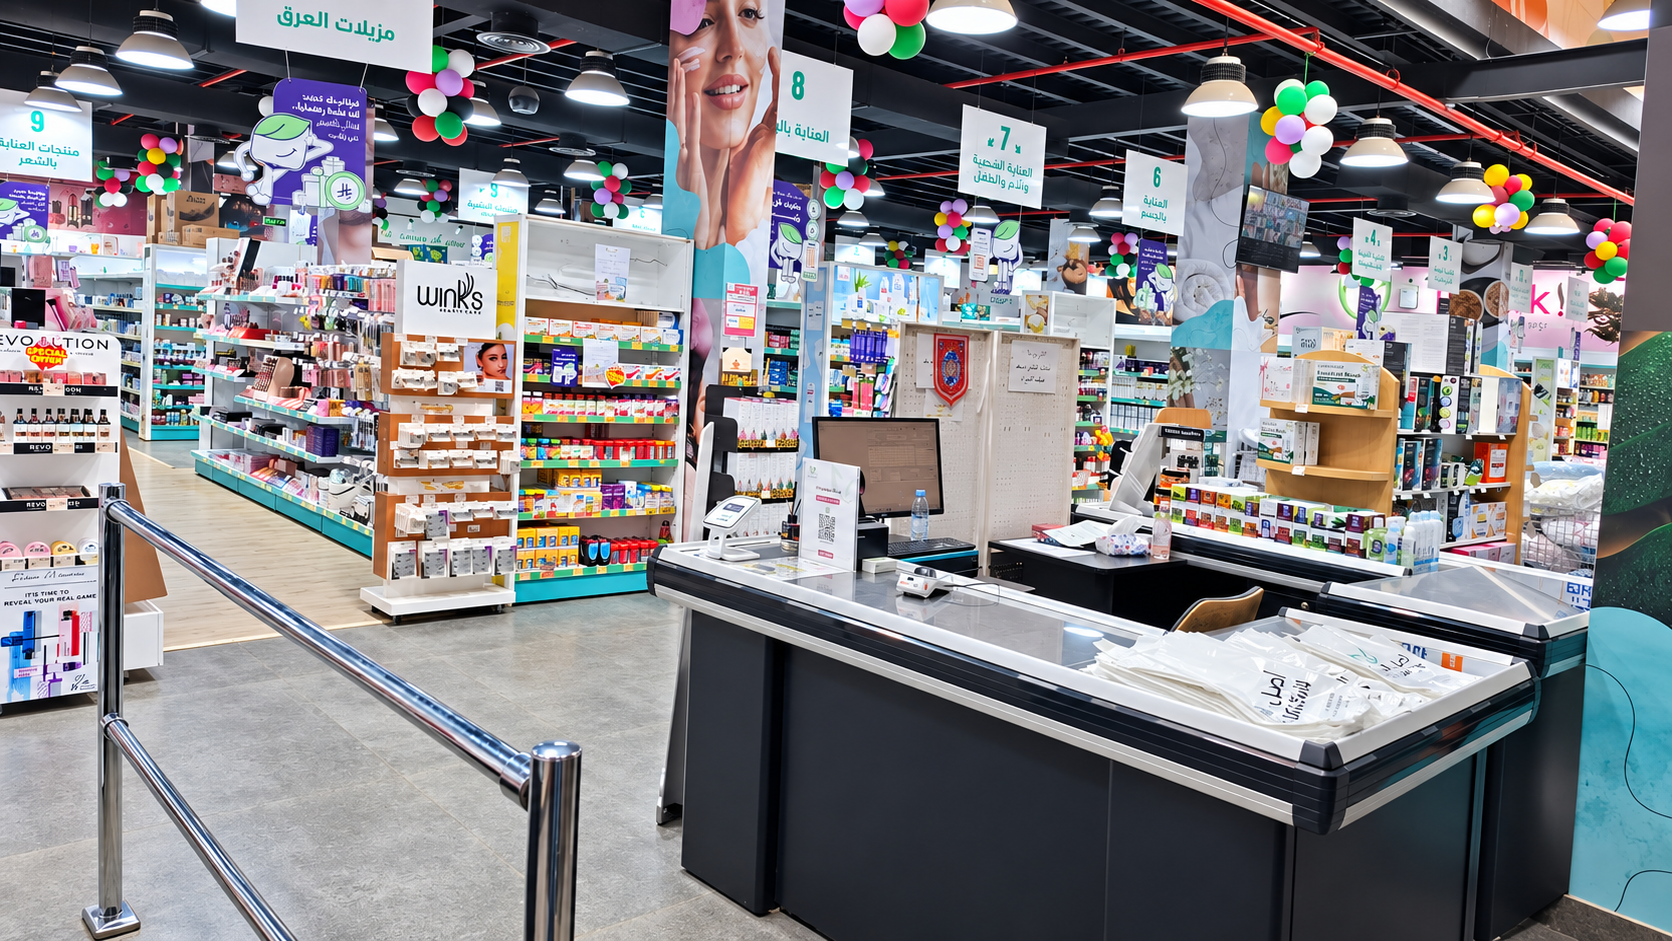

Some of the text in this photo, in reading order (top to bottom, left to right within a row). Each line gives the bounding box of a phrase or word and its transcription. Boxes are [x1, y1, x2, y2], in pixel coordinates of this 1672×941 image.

[277, 5, 396, 43] مزيلات العرق
[791, 70, 805, 101] 8
[30, 110, 45, 133] 9
[794, 123, 830, 143] العناية
[1000, 125, 1011, 151] 7
[18, 156, 57, 170] بالشعر
[1007, 163, 1033, 179] العناية
[1153, 166, 1161, 188] 6
[1143, 194, 1168, 209] العناية
[1140, 209, 1168, 225] بالجسم
[1370, 229, 1376, 246] 4
[1443, 245, 1449, 261] 3
[27, 347, 67, 358] SPECIAL
